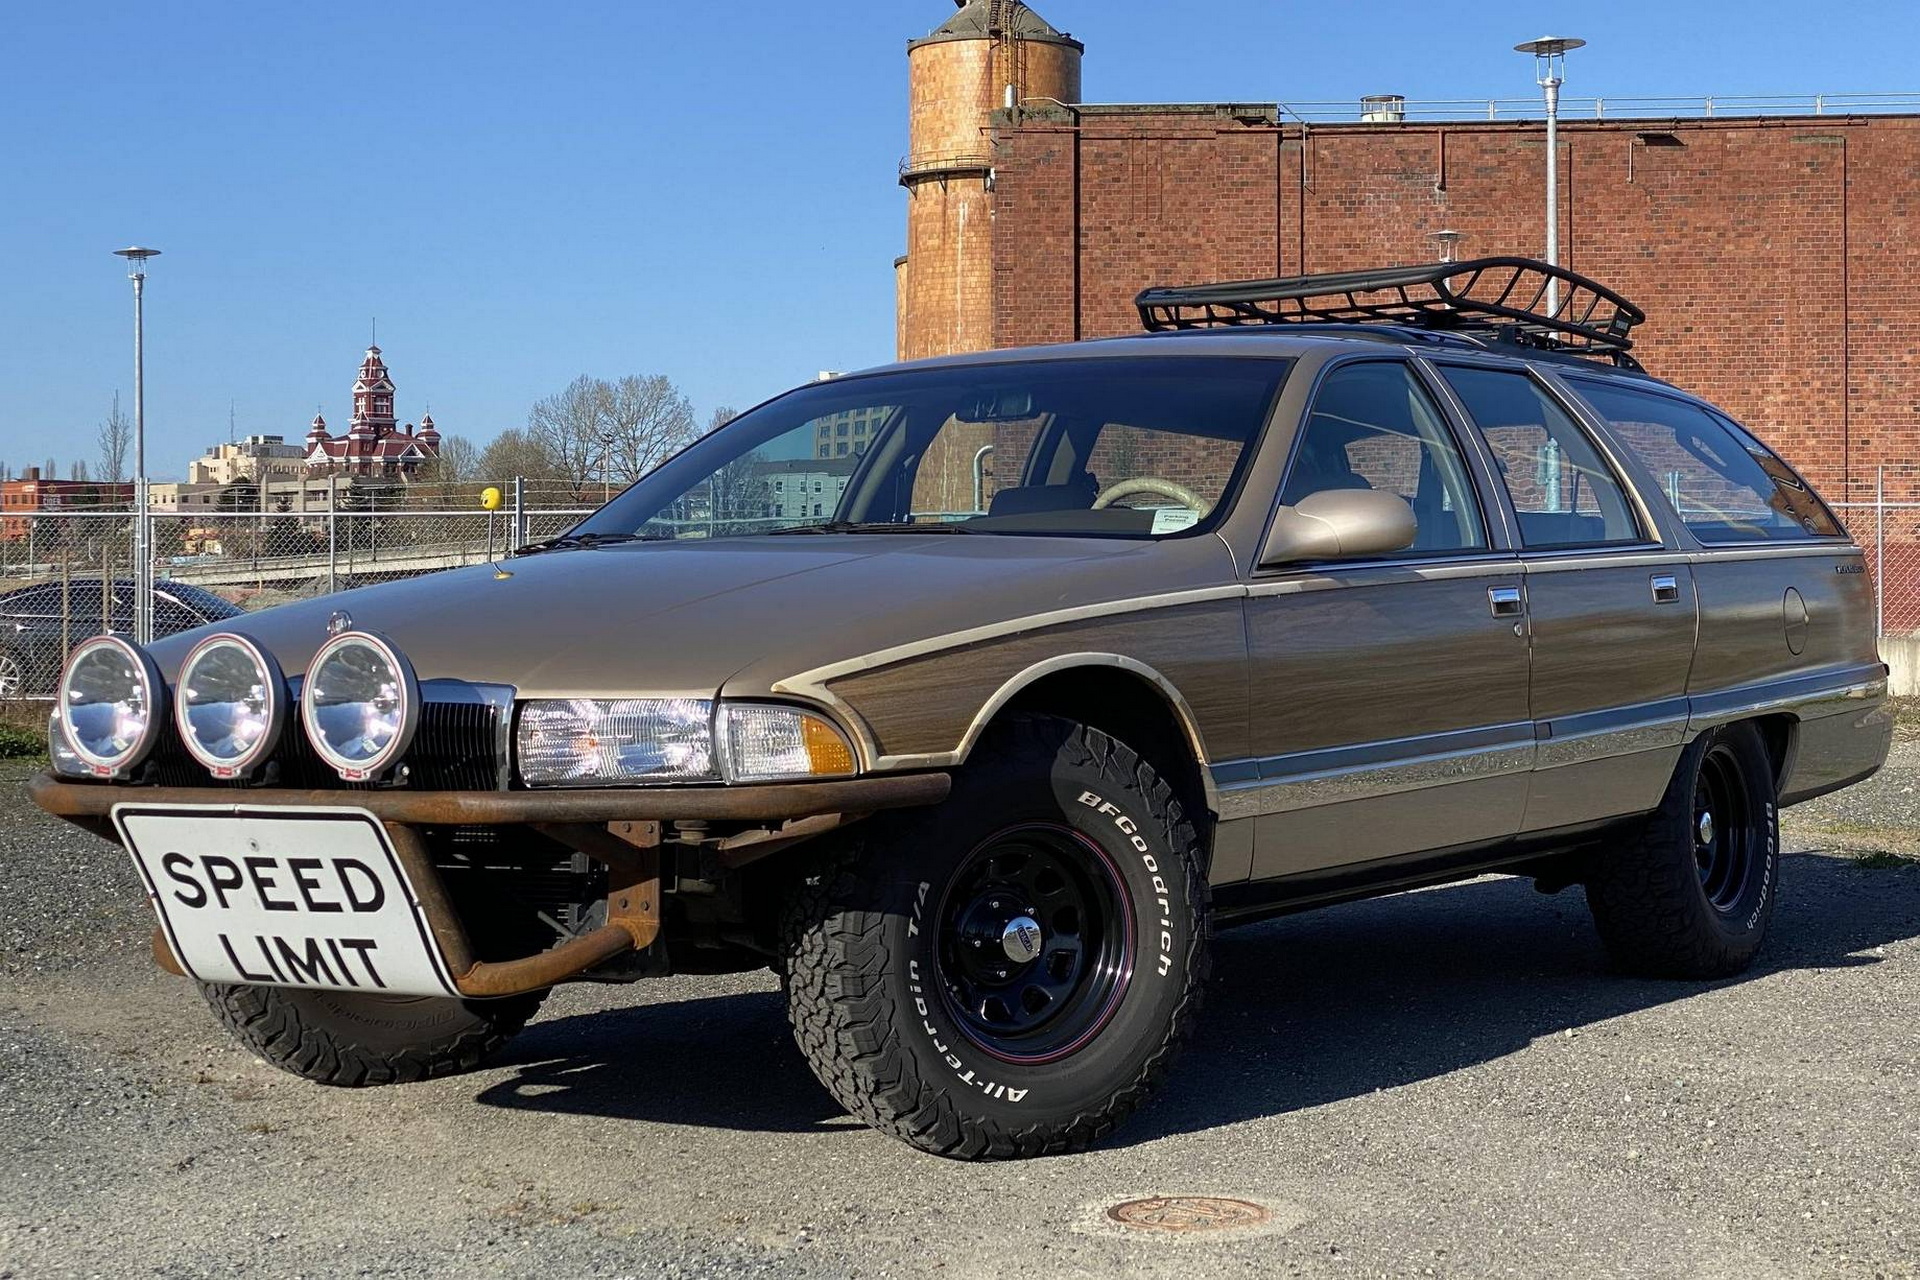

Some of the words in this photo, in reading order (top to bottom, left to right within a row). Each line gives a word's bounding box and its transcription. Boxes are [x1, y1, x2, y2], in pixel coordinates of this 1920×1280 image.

[160, 851, 387, 913] SPEED
[907, 881, 931, 938] T/A
[1077, 790, 1173, 977] BFGoodrich
[218, 933, 389, 989] LIMIT
[909, 959, 1030, 1103] All-Terrain
